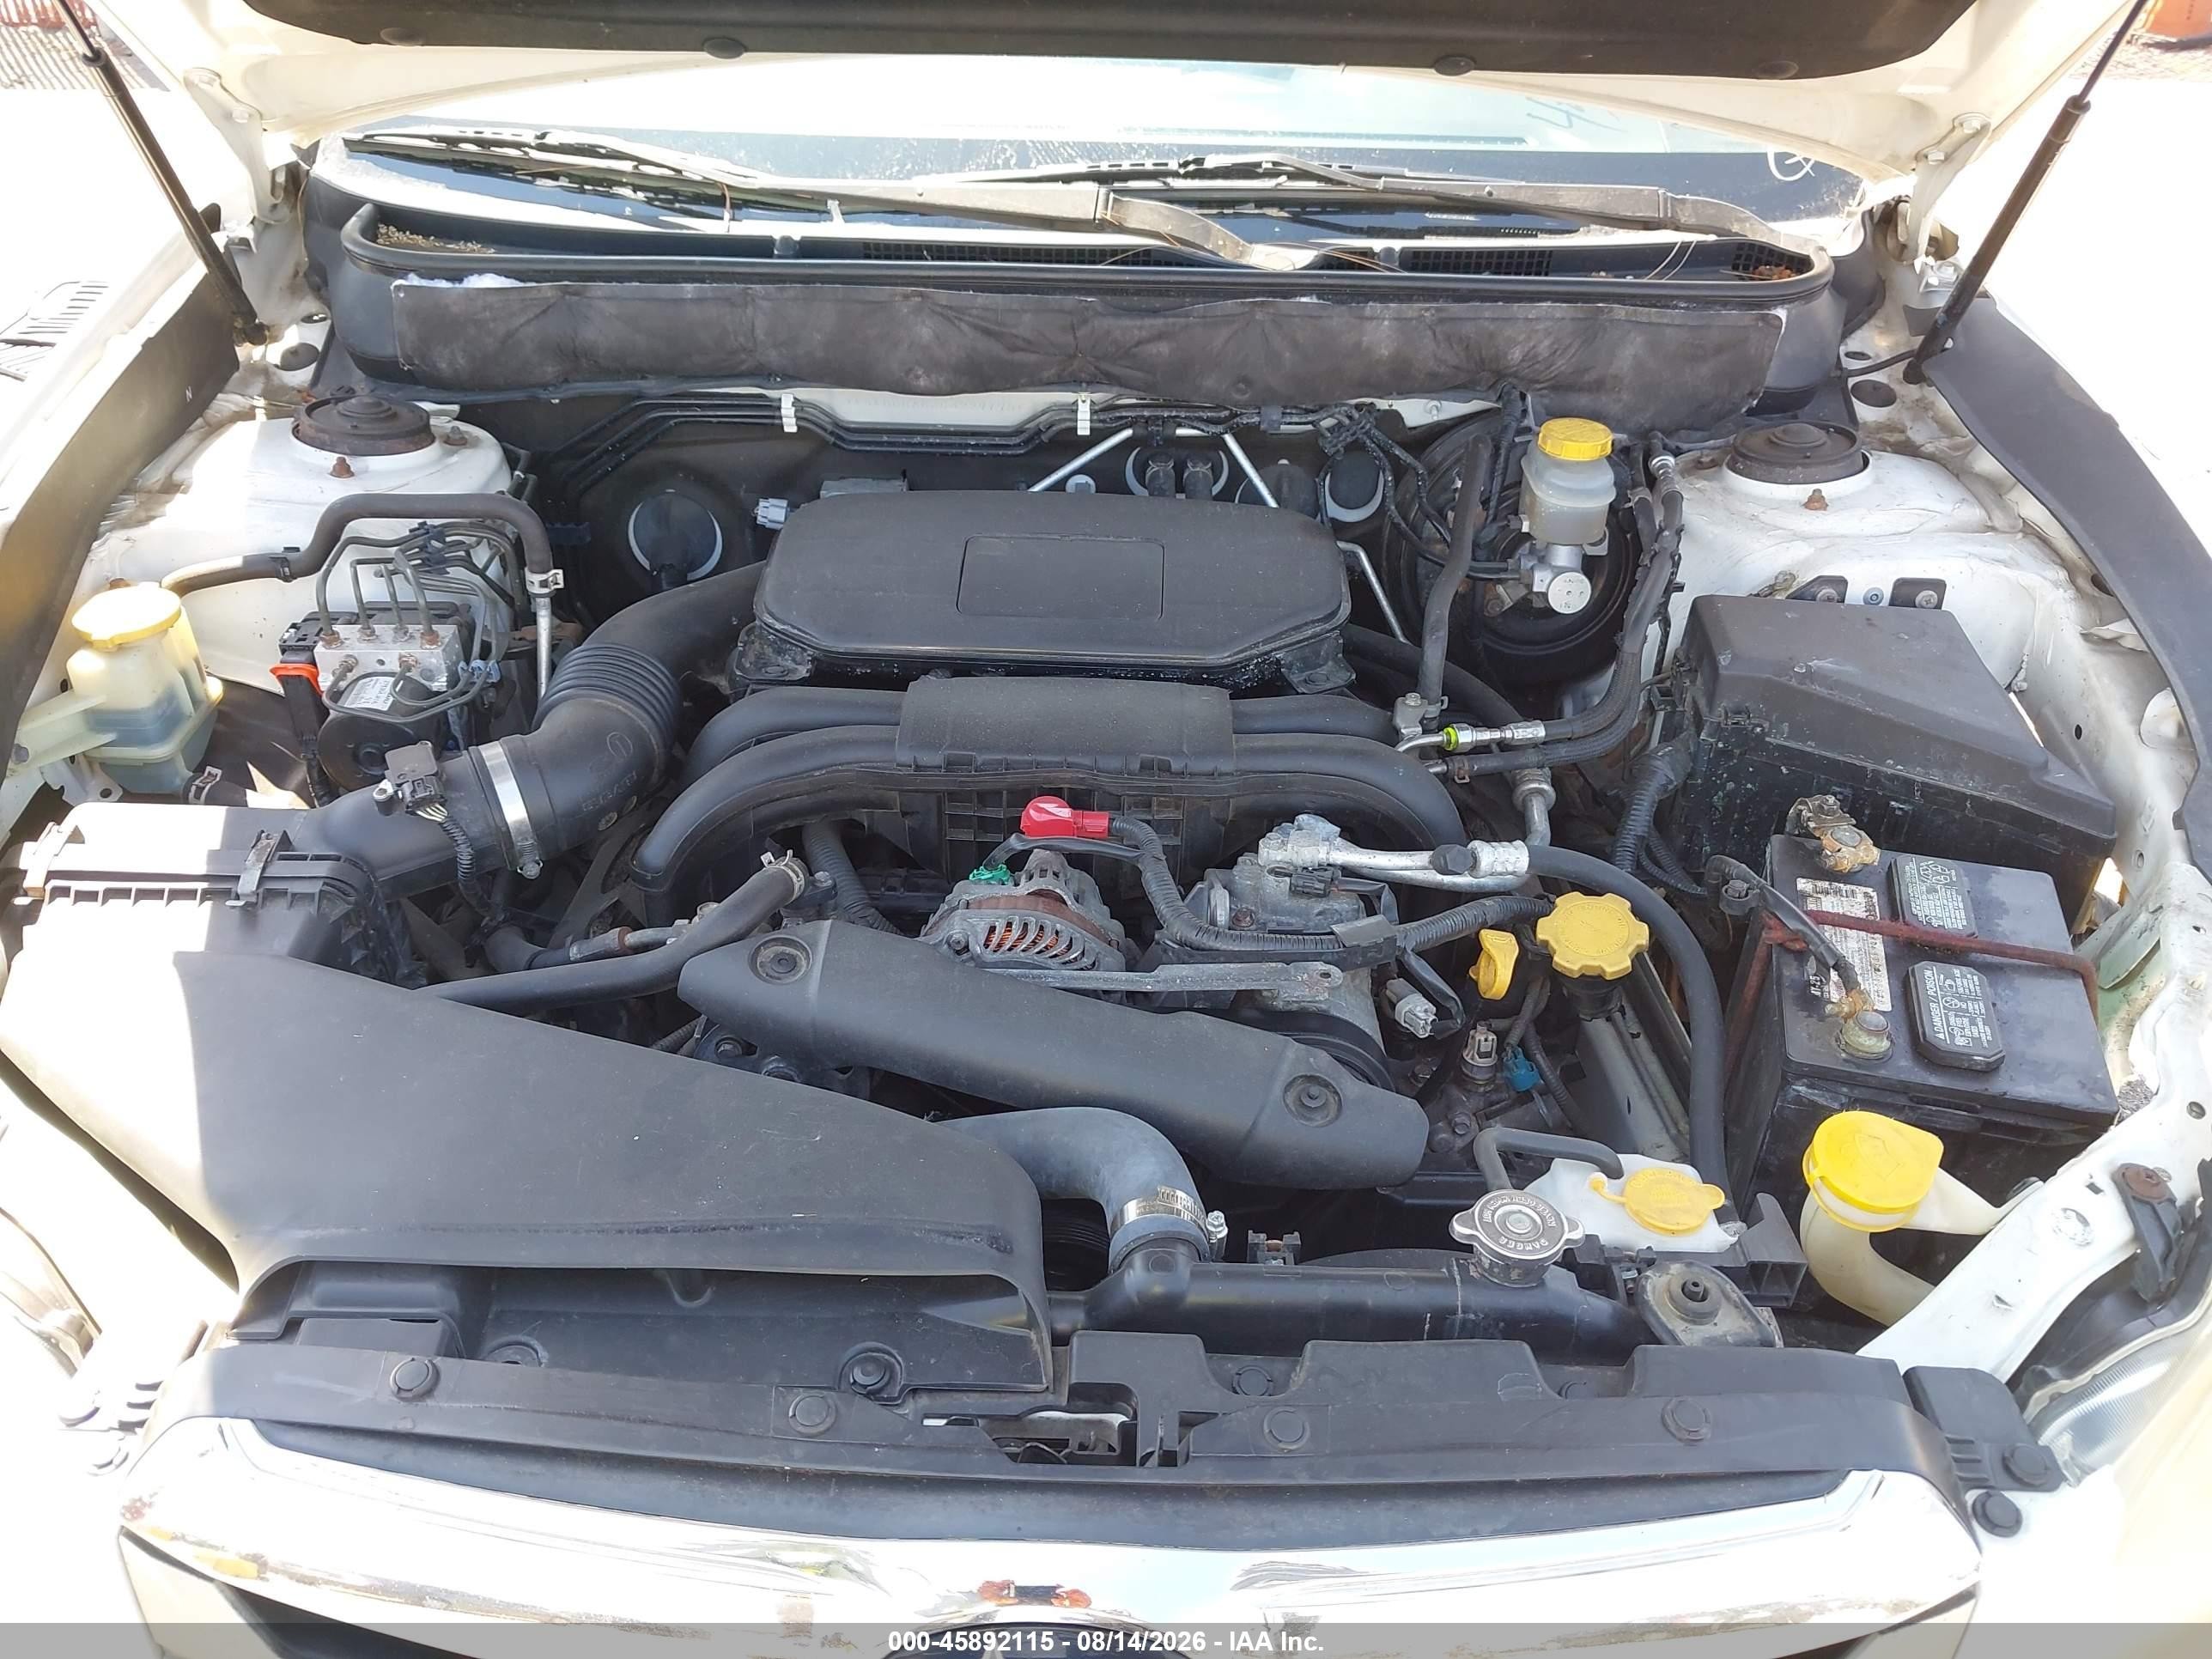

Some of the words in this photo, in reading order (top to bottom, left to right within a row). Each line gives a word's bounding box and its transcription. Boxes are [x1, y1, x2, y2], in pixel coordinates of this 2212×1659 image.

[1923, 969, 1937, 996] POISON
[1929, 1002, 1944, 1031] DANGER
[1498, 1236, 1549, 1251] DANGER
